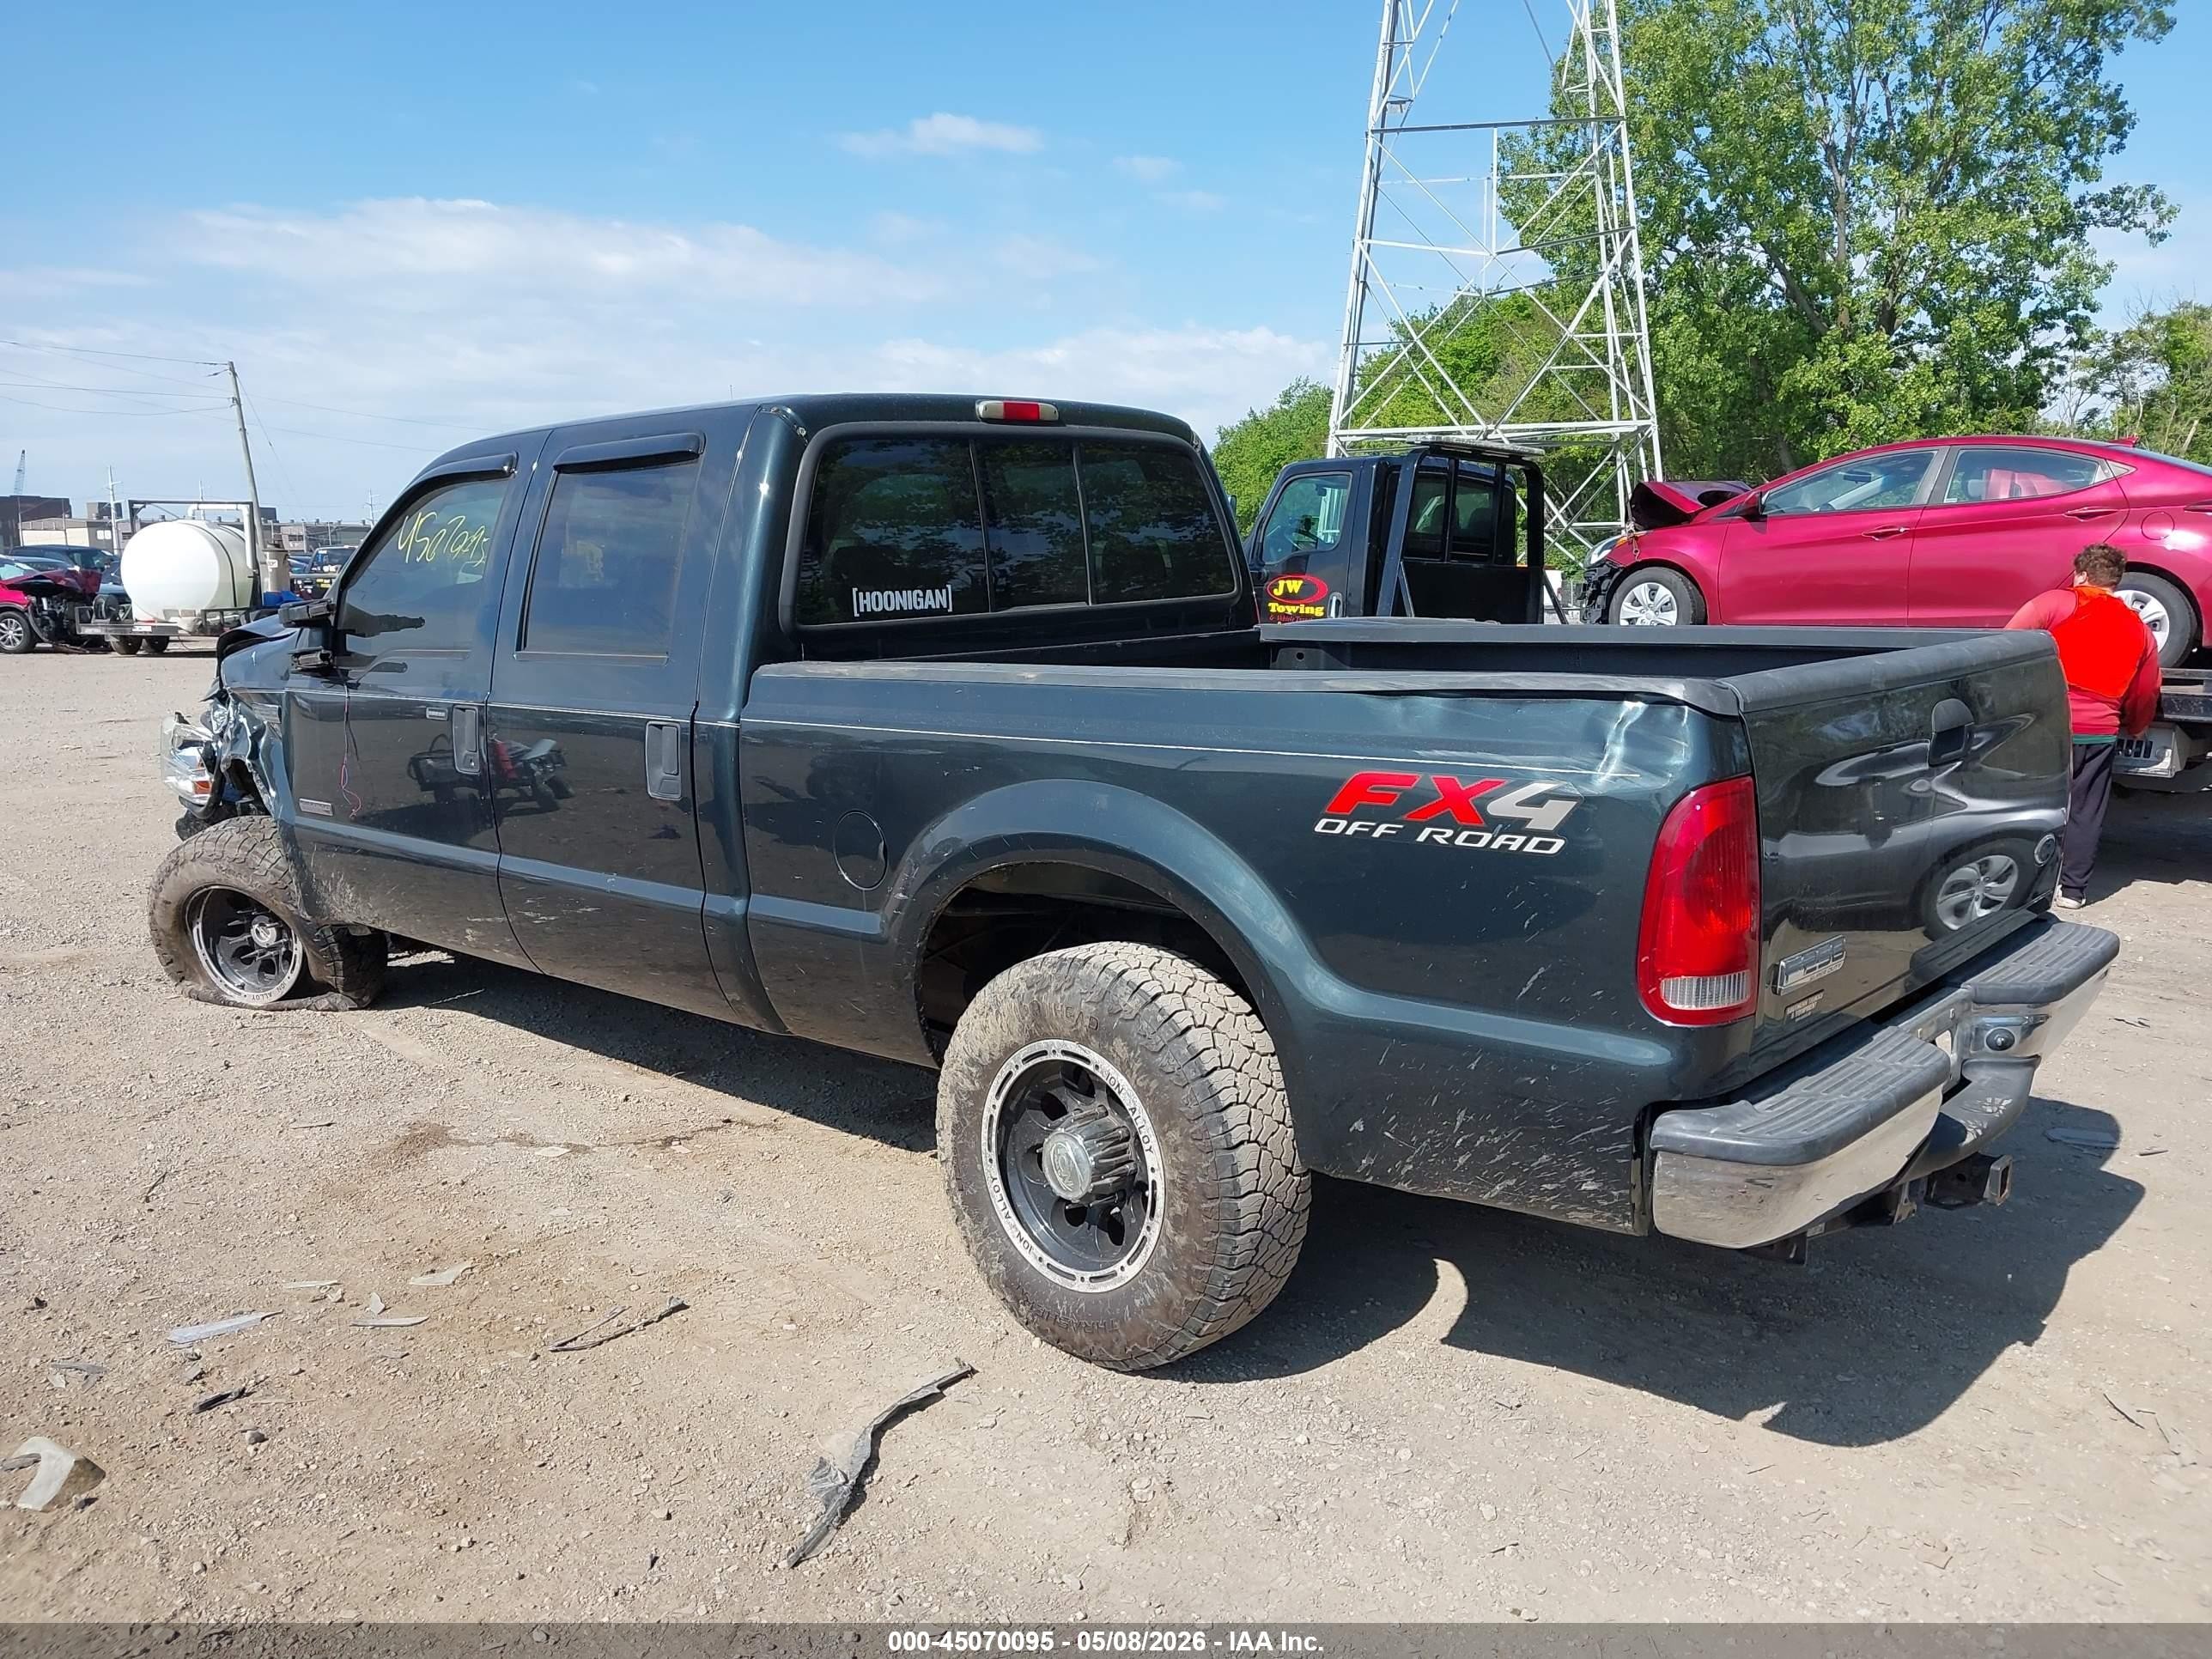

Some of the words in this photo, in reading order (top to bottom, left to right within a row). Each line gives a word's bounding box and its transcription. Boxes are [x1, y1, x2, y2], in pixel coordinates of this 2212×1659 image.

[1273, 580, 1304, 596] JW
[1268, 603, 1324, 617] Towing
[1324, 770, 1578, 831] FX4
[1314, 818, 1404, 838] OFF
[1416, 827, 1565, 854] ROAD
[1105, 1073, 1124, 1095] ION
[1128, 1106, 1154, 1155] ALLOY
[990, 1176, 1012, 1219] ALLOY
[1016, 1231, 1035, 1254] ION
